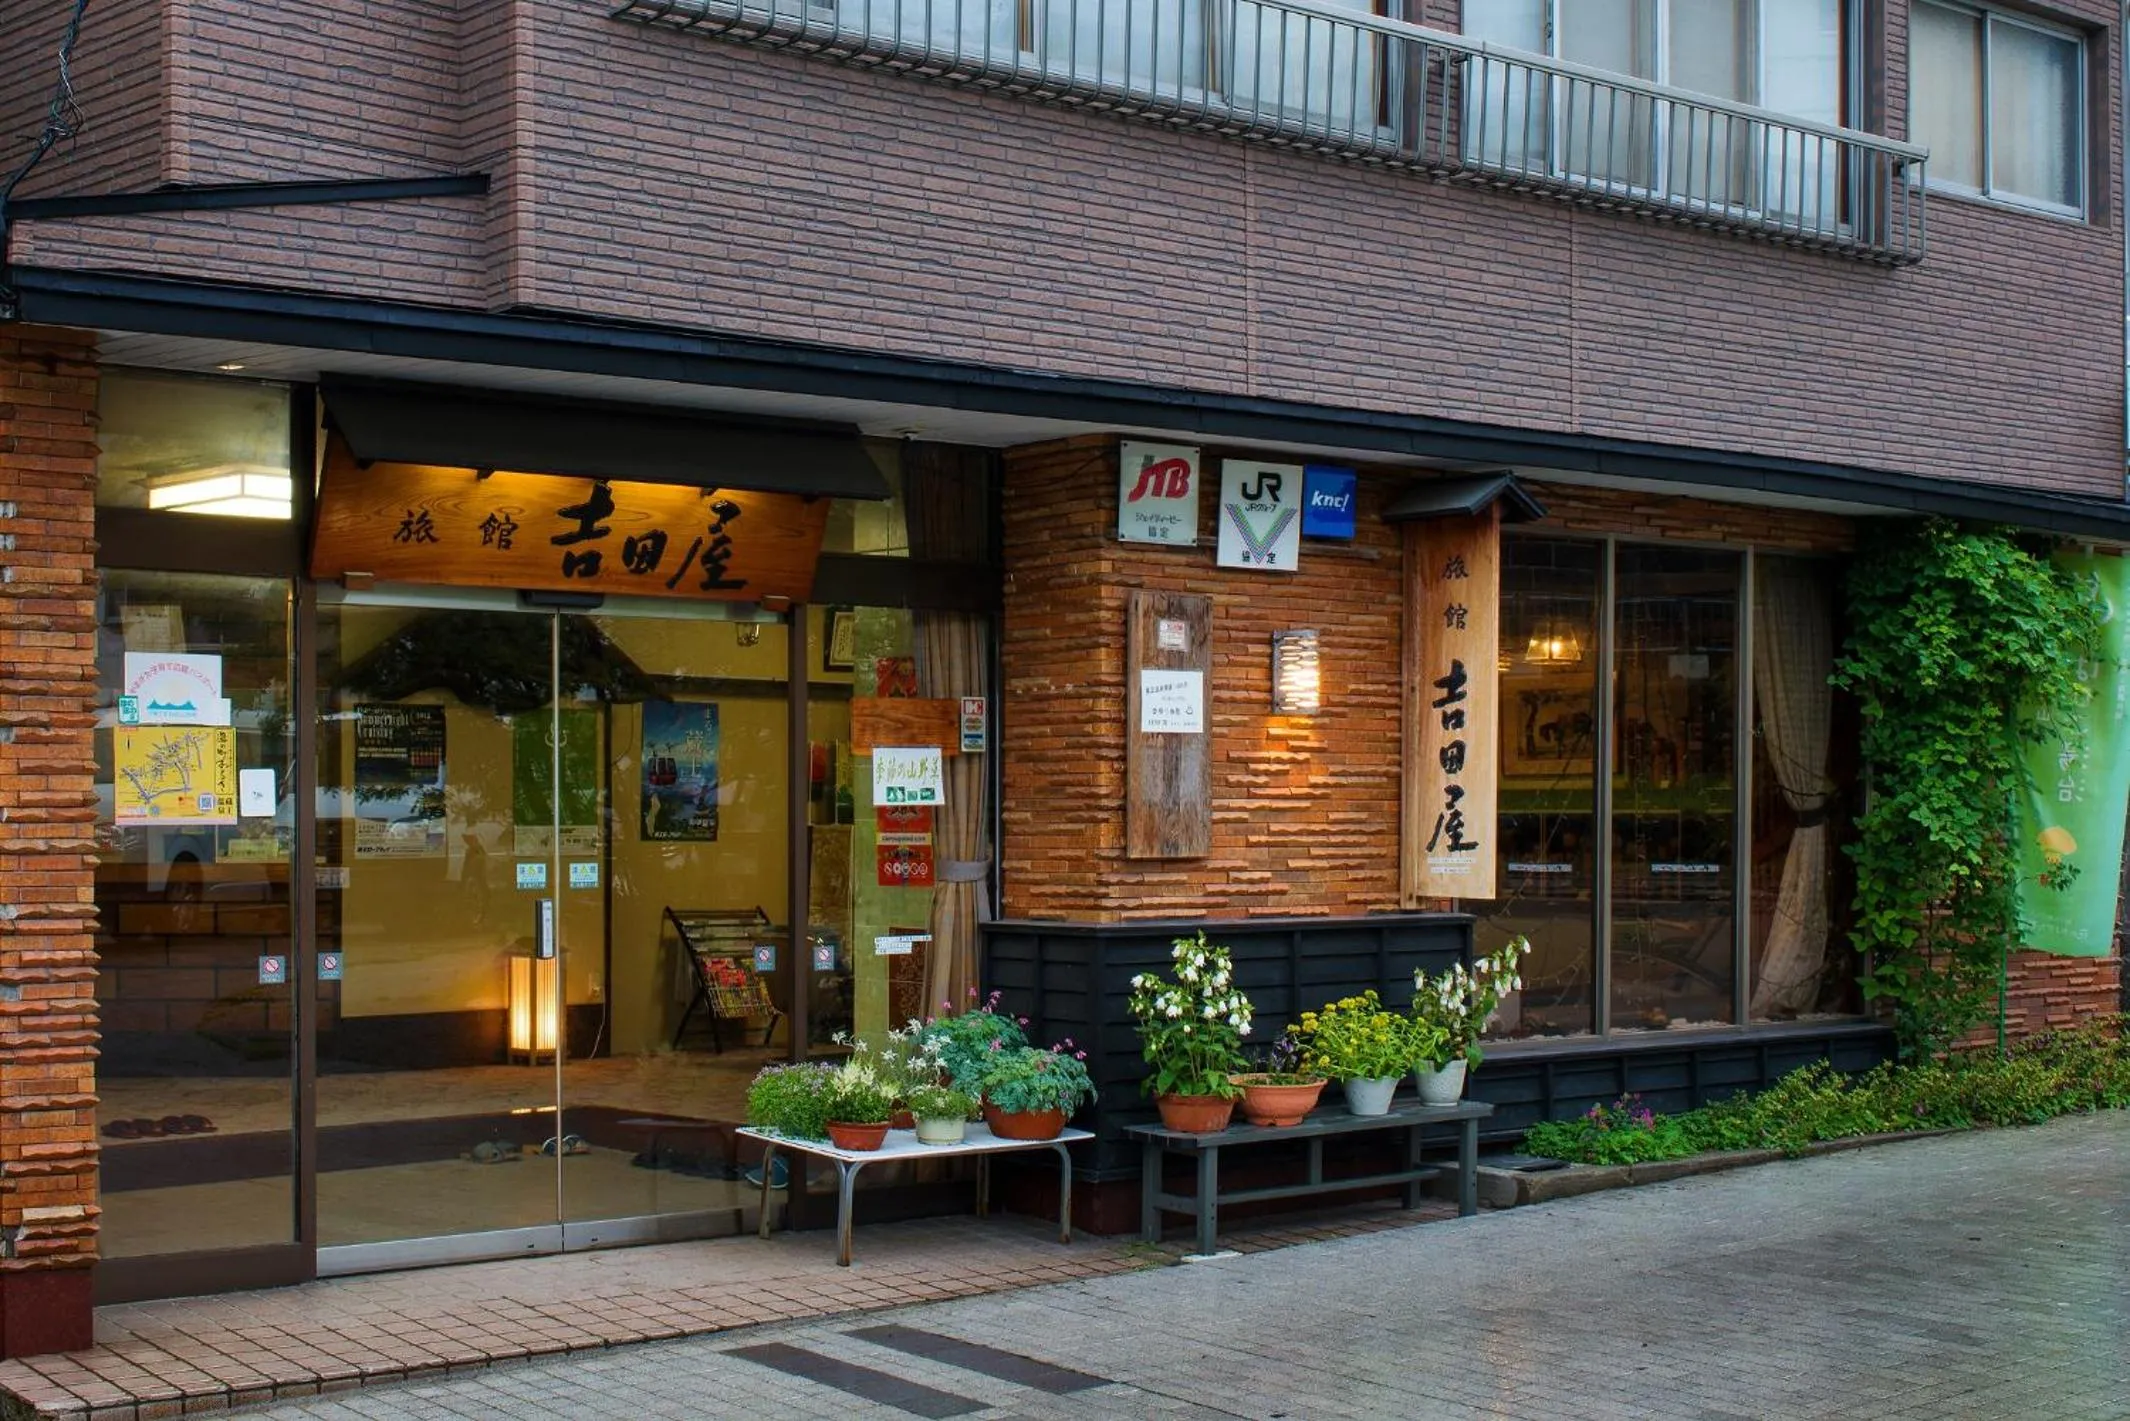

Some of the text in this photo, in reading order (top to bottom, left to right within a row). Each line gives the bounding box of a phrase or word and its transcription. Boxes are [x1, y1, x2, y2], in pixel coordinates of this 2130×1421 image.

[1127, 454, 1191, 503] JTB
[1241, 471, 1282, 503] JR
[393, 480, 748, 591] 旅館 吉田屋
[1441, 556, 1469, 631] 旅館
[1426, 658, 1479, 853] 吉田屋
